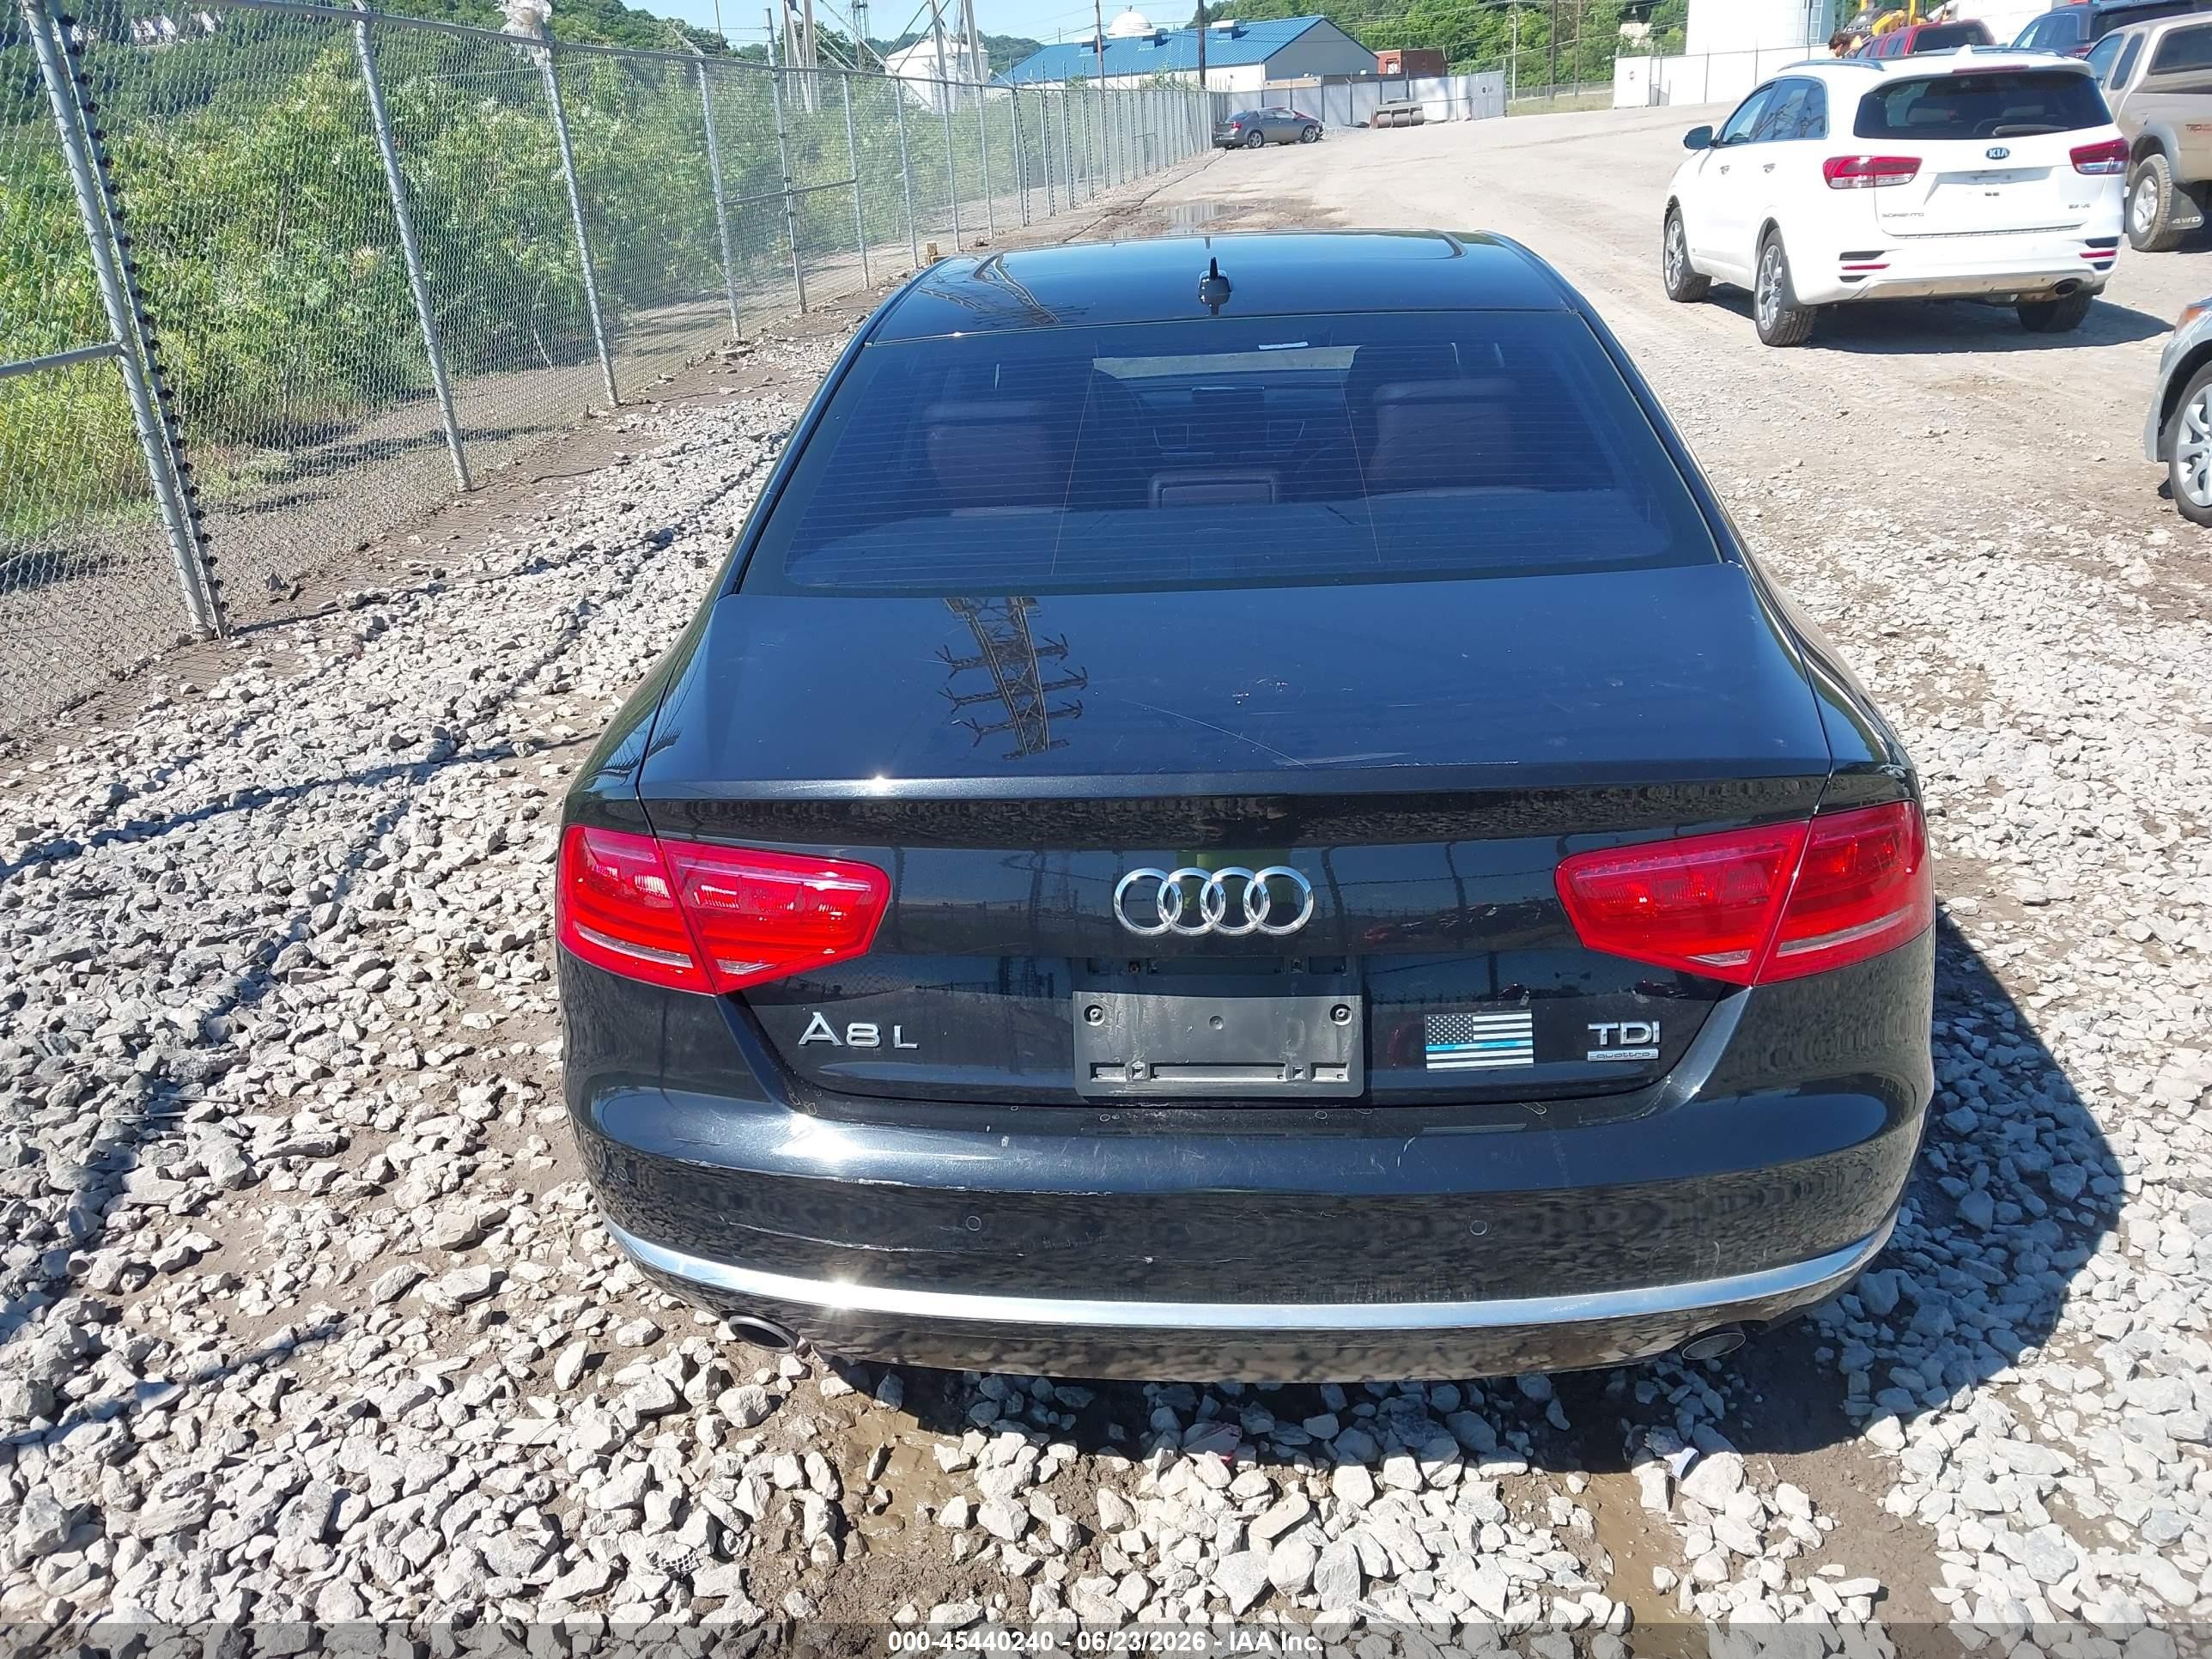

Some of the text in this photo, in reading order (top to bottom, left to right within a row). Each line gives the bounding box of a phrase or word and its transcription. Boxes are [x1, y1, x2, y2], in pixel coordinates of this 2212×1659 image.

[1989, 149, 2008, 158] KIA
[2172, 216, 2201, 224] 4WD
[798, 1012, 919, 1048] A8 L
[1587, 1020, 1661, 1046] TDI
[1596, 1051, 1650, 1060] quattro
